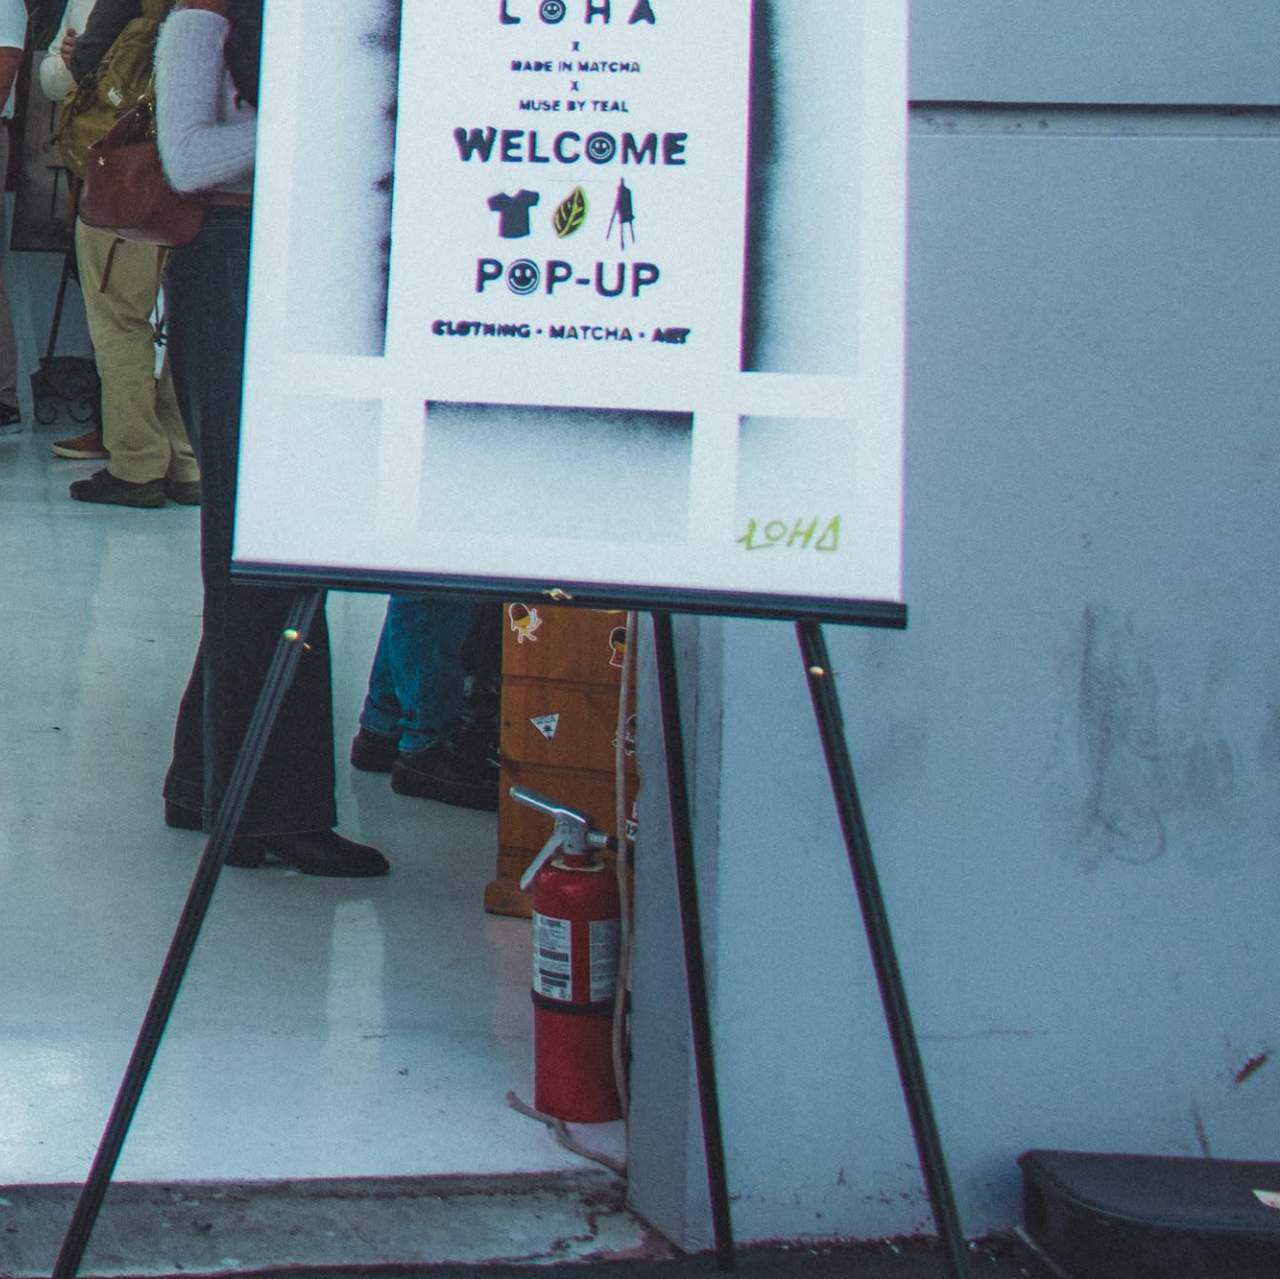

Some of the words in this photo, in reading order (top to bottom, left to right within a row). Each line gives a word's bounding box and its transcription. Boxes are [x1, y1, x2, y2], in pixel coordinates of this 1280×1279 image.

[510, 60, 553, 73] MADE
[558, 61, 573, 73] IN
[577, 61, 641, 73] MATCHA
[519, 99, 561, 112] MUSE
[566, 100, 586, 112] BY
[592, 100, 630, 113] TEAL
[452, 126, 689, 166] WELCOME
[475, 257, 660, 298] POP-UP
[431, 319, 531, 338] CLOTHING
[548, 324, 633, 342] MATCHA
[651, 327, 692, 344] ART
[736, 514, 842, 552] LOHA
